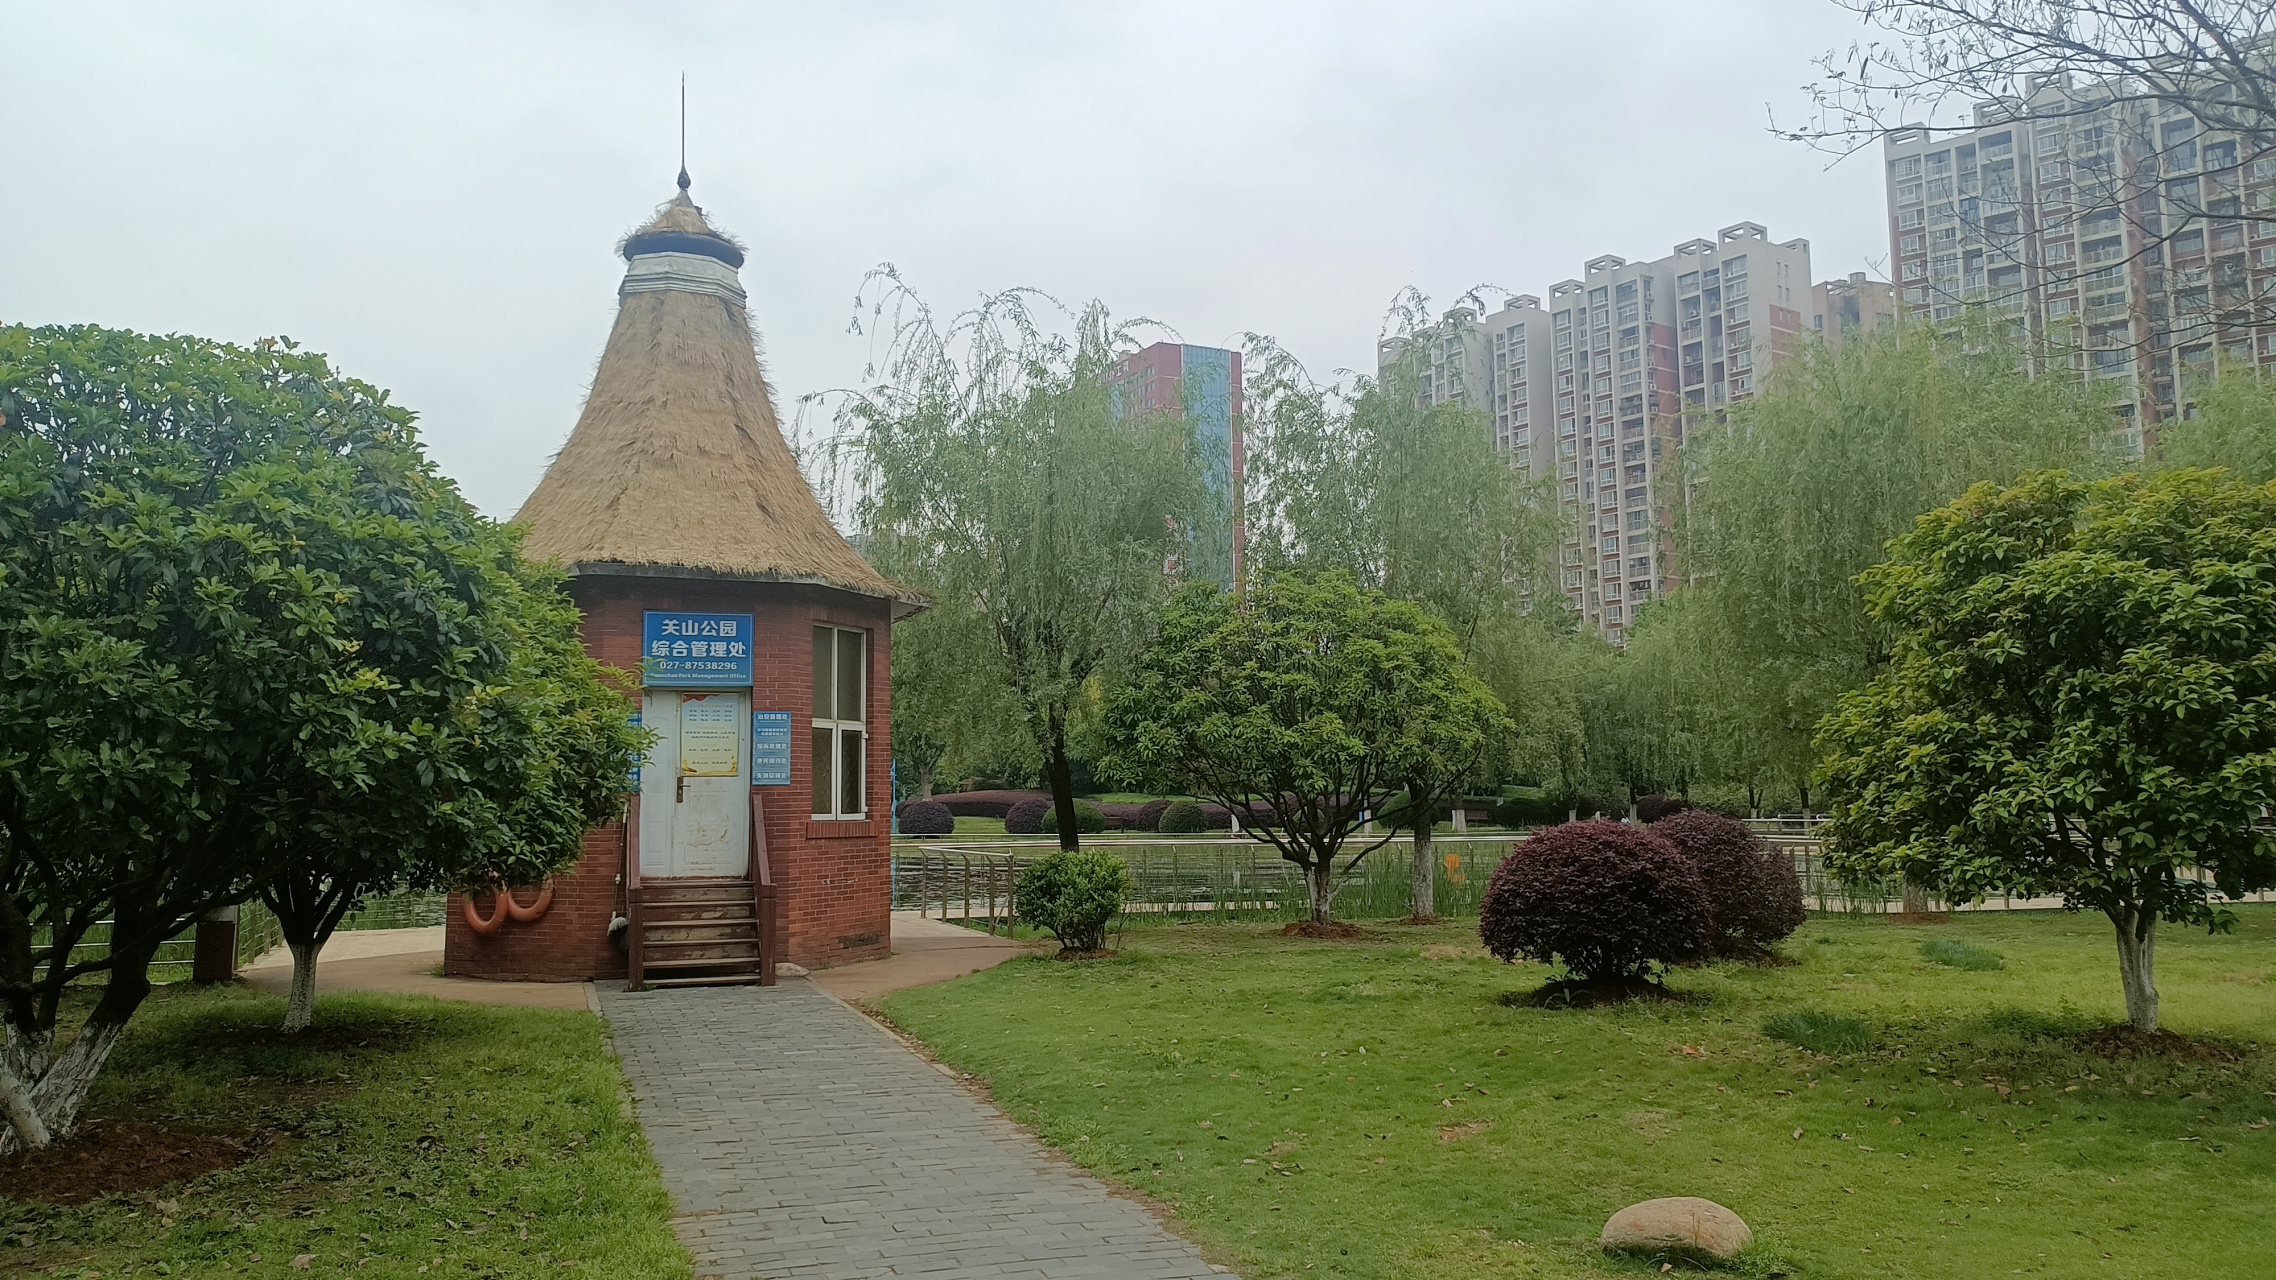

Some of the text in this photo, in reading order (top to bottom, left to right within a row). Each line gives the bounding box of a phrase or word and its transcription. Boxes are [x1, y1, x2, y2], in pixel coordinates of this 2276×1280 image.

[661, 619, 737, 637] 关山公园
[651, 640, 746, 658] 综合管理处
[659, 661, 737, 670] 027-87538296
[692, 672, 729, 680] Management
